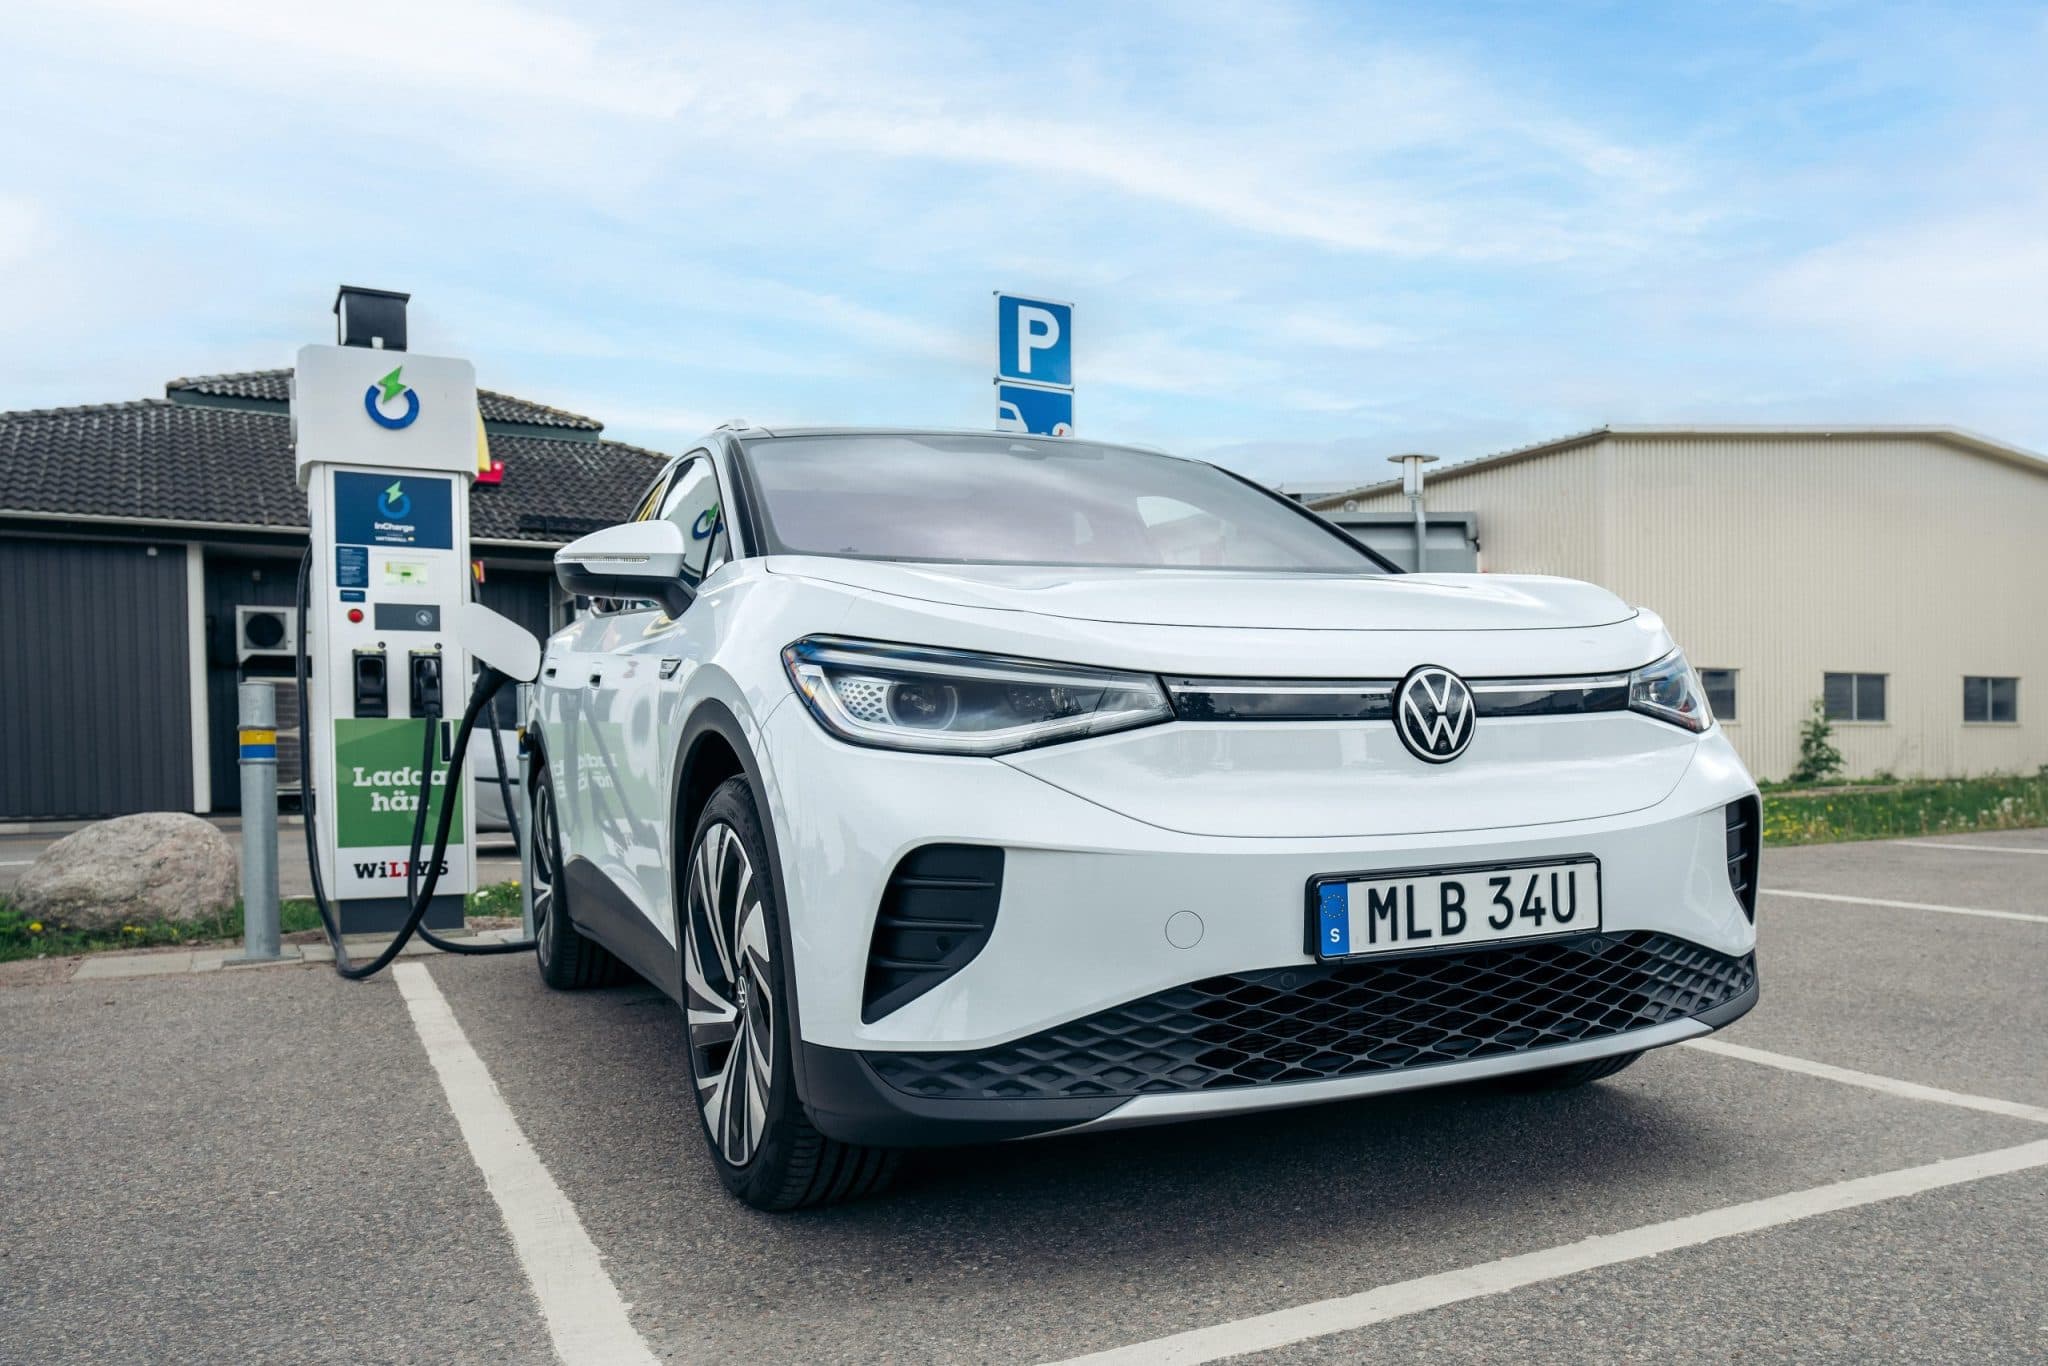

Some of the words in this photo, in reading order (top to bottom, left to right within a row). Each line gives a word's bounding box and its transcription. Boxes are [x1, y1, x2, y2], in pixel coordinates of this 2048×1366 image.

[1018, 305, 1060, 374] P
[1330, 928, 1341, 943] S
[1367, 880, 1467, 944] MLB
[1488, 871, 1576, 930] 34U
